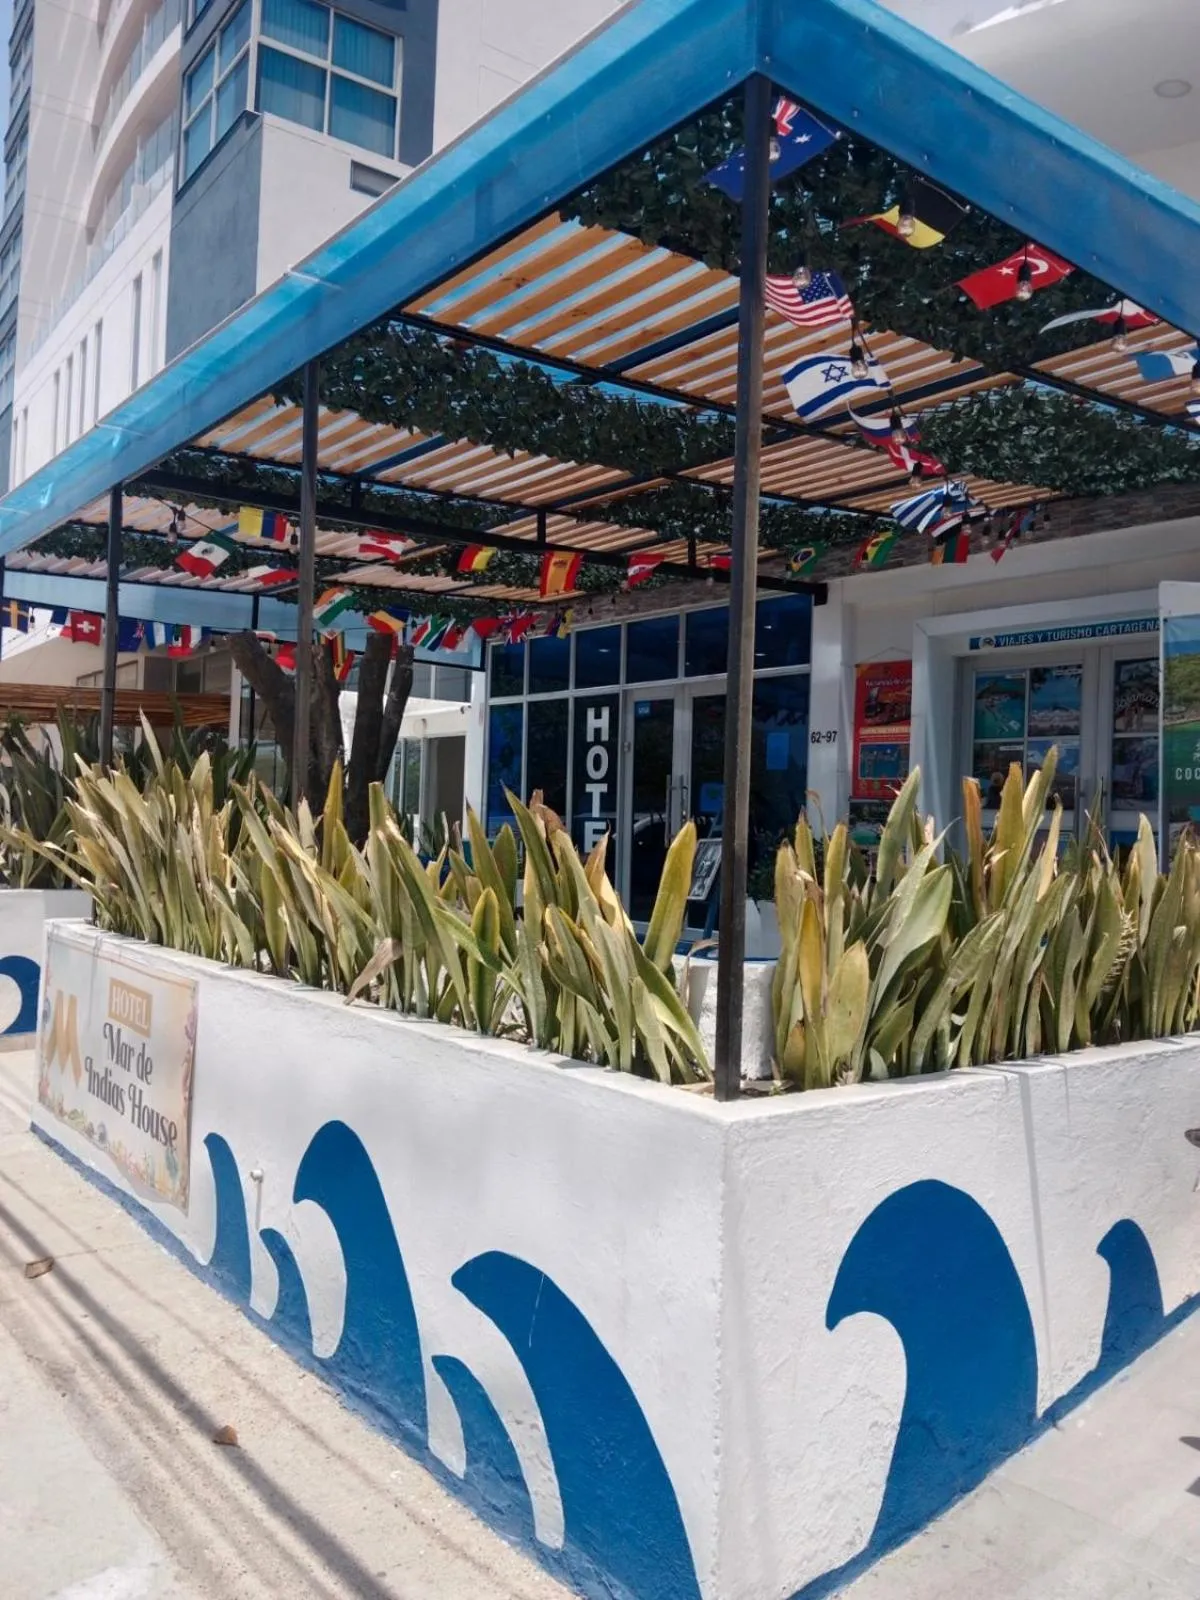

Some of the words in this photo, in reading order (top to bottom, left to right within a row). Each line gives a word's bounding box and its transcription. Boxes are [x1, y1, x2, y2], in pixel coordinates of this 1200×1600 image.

[1000, 632, 1034, 646] VIAJES
[1037, 632, 1044, 643] Y
[1047, 628, 1092, 641] TURISMO
[1095, 620, 1160, 637] CARTAGENA
[811, 730, 838, 744] 62-97
[583, 706, 610, 853] HOTE
[112, 984, 149, 1030] HOTEL
[103, 1022, 135, 1073] Mar
[136, 1043, 153, 1085] de
[84, 1056, 126, 1116] Indias
[128, 1083, 178, 1148] House
